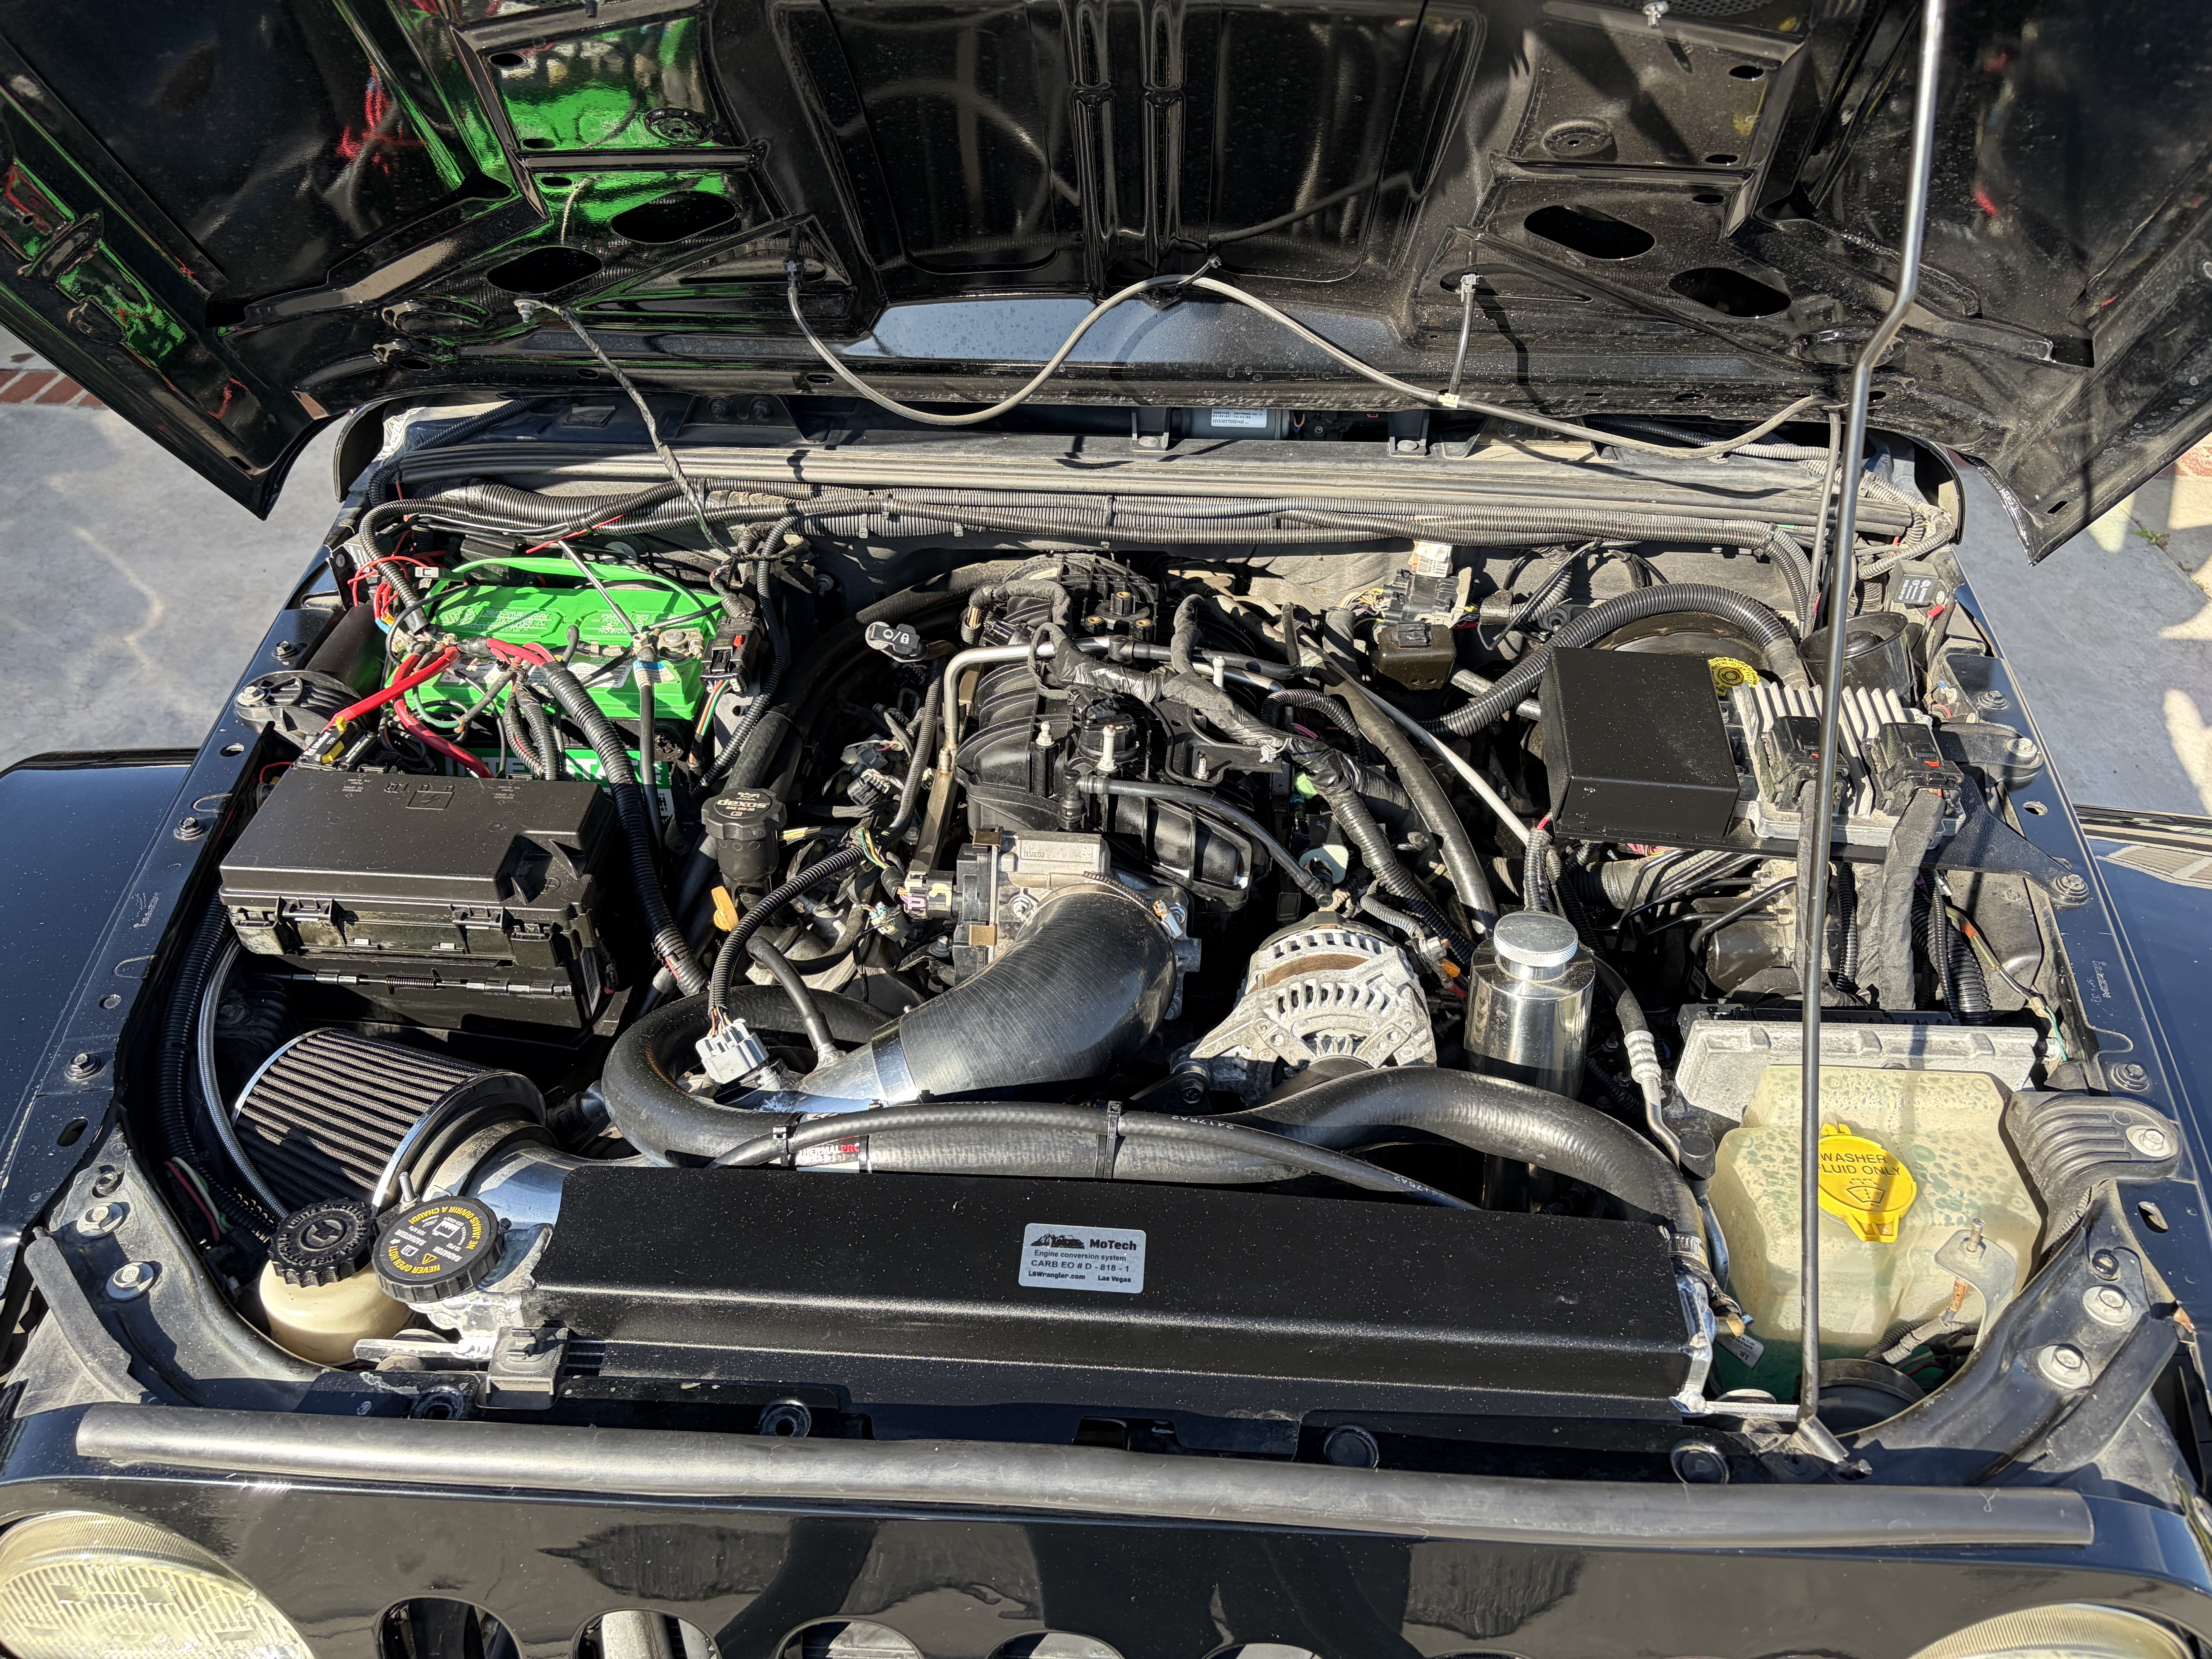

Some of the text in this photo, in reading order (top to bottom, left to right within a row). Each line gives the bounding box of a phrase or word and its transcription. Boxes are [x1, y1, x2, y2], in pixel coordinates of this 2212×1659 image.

[717, 799, 768, 808] dexos
[1820, 1153, 1887, 1163] WASHER
[1819, 1164, 1901, 1176] LUID ONLY
[408, 1207, 440, 1224] CHAUD!
[450, 1206, 474, 1219] OUVRIR
[471, 1217, 482, 1240] JAMAIS
[394, 1228, 427, 1246] RADIATEUR
[466, 1240, 477, 1249] NE
[1089, 1239, 1137, 1250] MoTech
[388, 1245, 440, 1274] NEVER OPEN HOT!
[432, 1246, 462, 1262] RADIATOR
[1034, 1249, 1059, 1258] Engine
[1031, 1260, 1058, 1268] CARB
